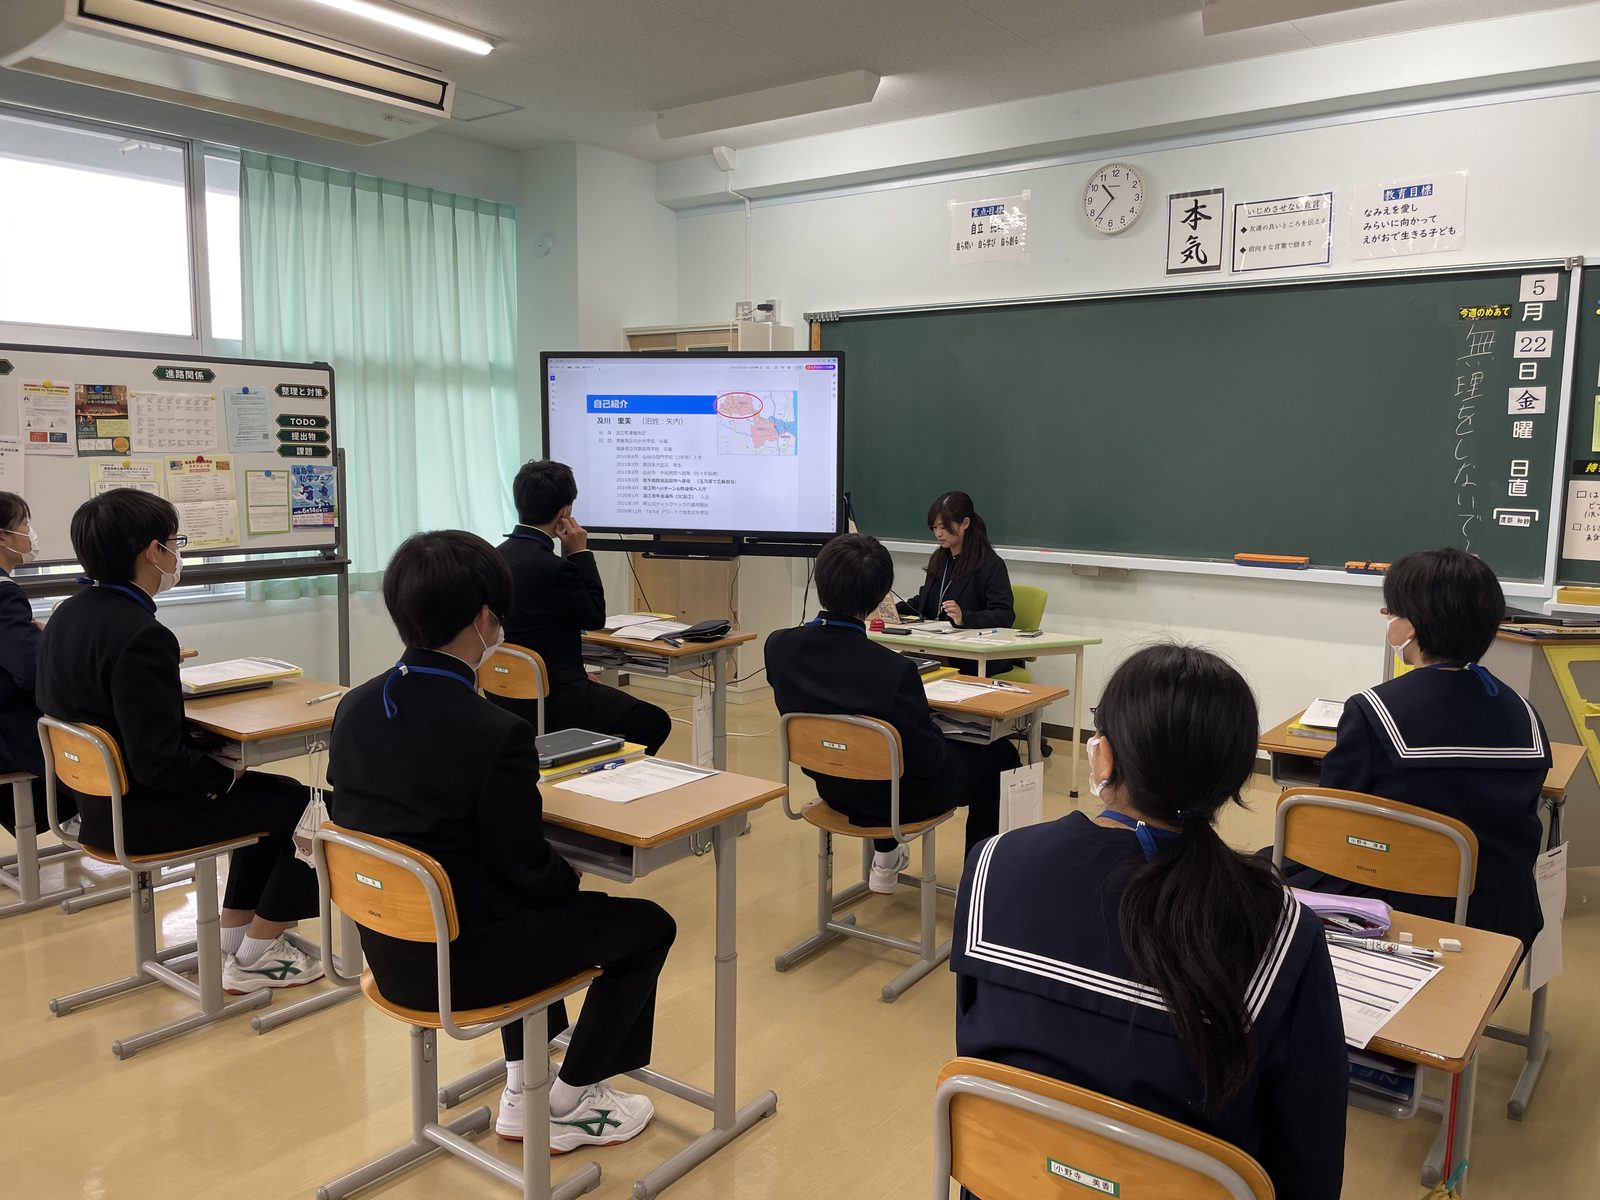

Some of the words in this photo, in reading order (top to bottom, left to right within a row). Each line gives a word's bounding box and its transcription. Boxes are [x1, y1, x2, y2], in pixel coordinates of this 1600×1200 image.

[1100, 174, 1107, 182] 11
[1112, 169, 1120, 178] 12
[1091, 184, 1099, 192] 10
[1132, 180, 1138, 189] 2
[1134, 193, 1140, 202] 3
[1385, 184, 1432, 201] 教育目標
[1087, 197, 1093, 205] 9
[1090, 209, 1096, 217] 8
[1129, 206, 1135, 214] 4
[1364, 203, 1419, 217] なみえを愛し
[1098, 217, 1104, 225] 7
[1108, 219, 1114, 228] 6
[1120, 216, 1126, 224] 5
[1363, 215, 1438, 231] みらいに向かって
[971, 221, 984, 235] 自立
[1180, 198, 1212, 265] 本気
[1363, 227, 1456, 244] えがおで生きる子ども
[978, 238, 996, 249] 自ら学び
[1459, 306, 1511, 319] 今週のめあて
[165, 369, 205, 381] 進路関係
[281, 386, 323, 397] 整理と対策
[593, 399, 629, 409] 自己紹介
[289, 418, 316, 426] TODO
[291, 431, 316, 441] 提出物
[296, 446, 313, 456] 課題
[1585, 462, 1600, 473] 持
[1055, 1165, 1082, 1181] 小野寺
